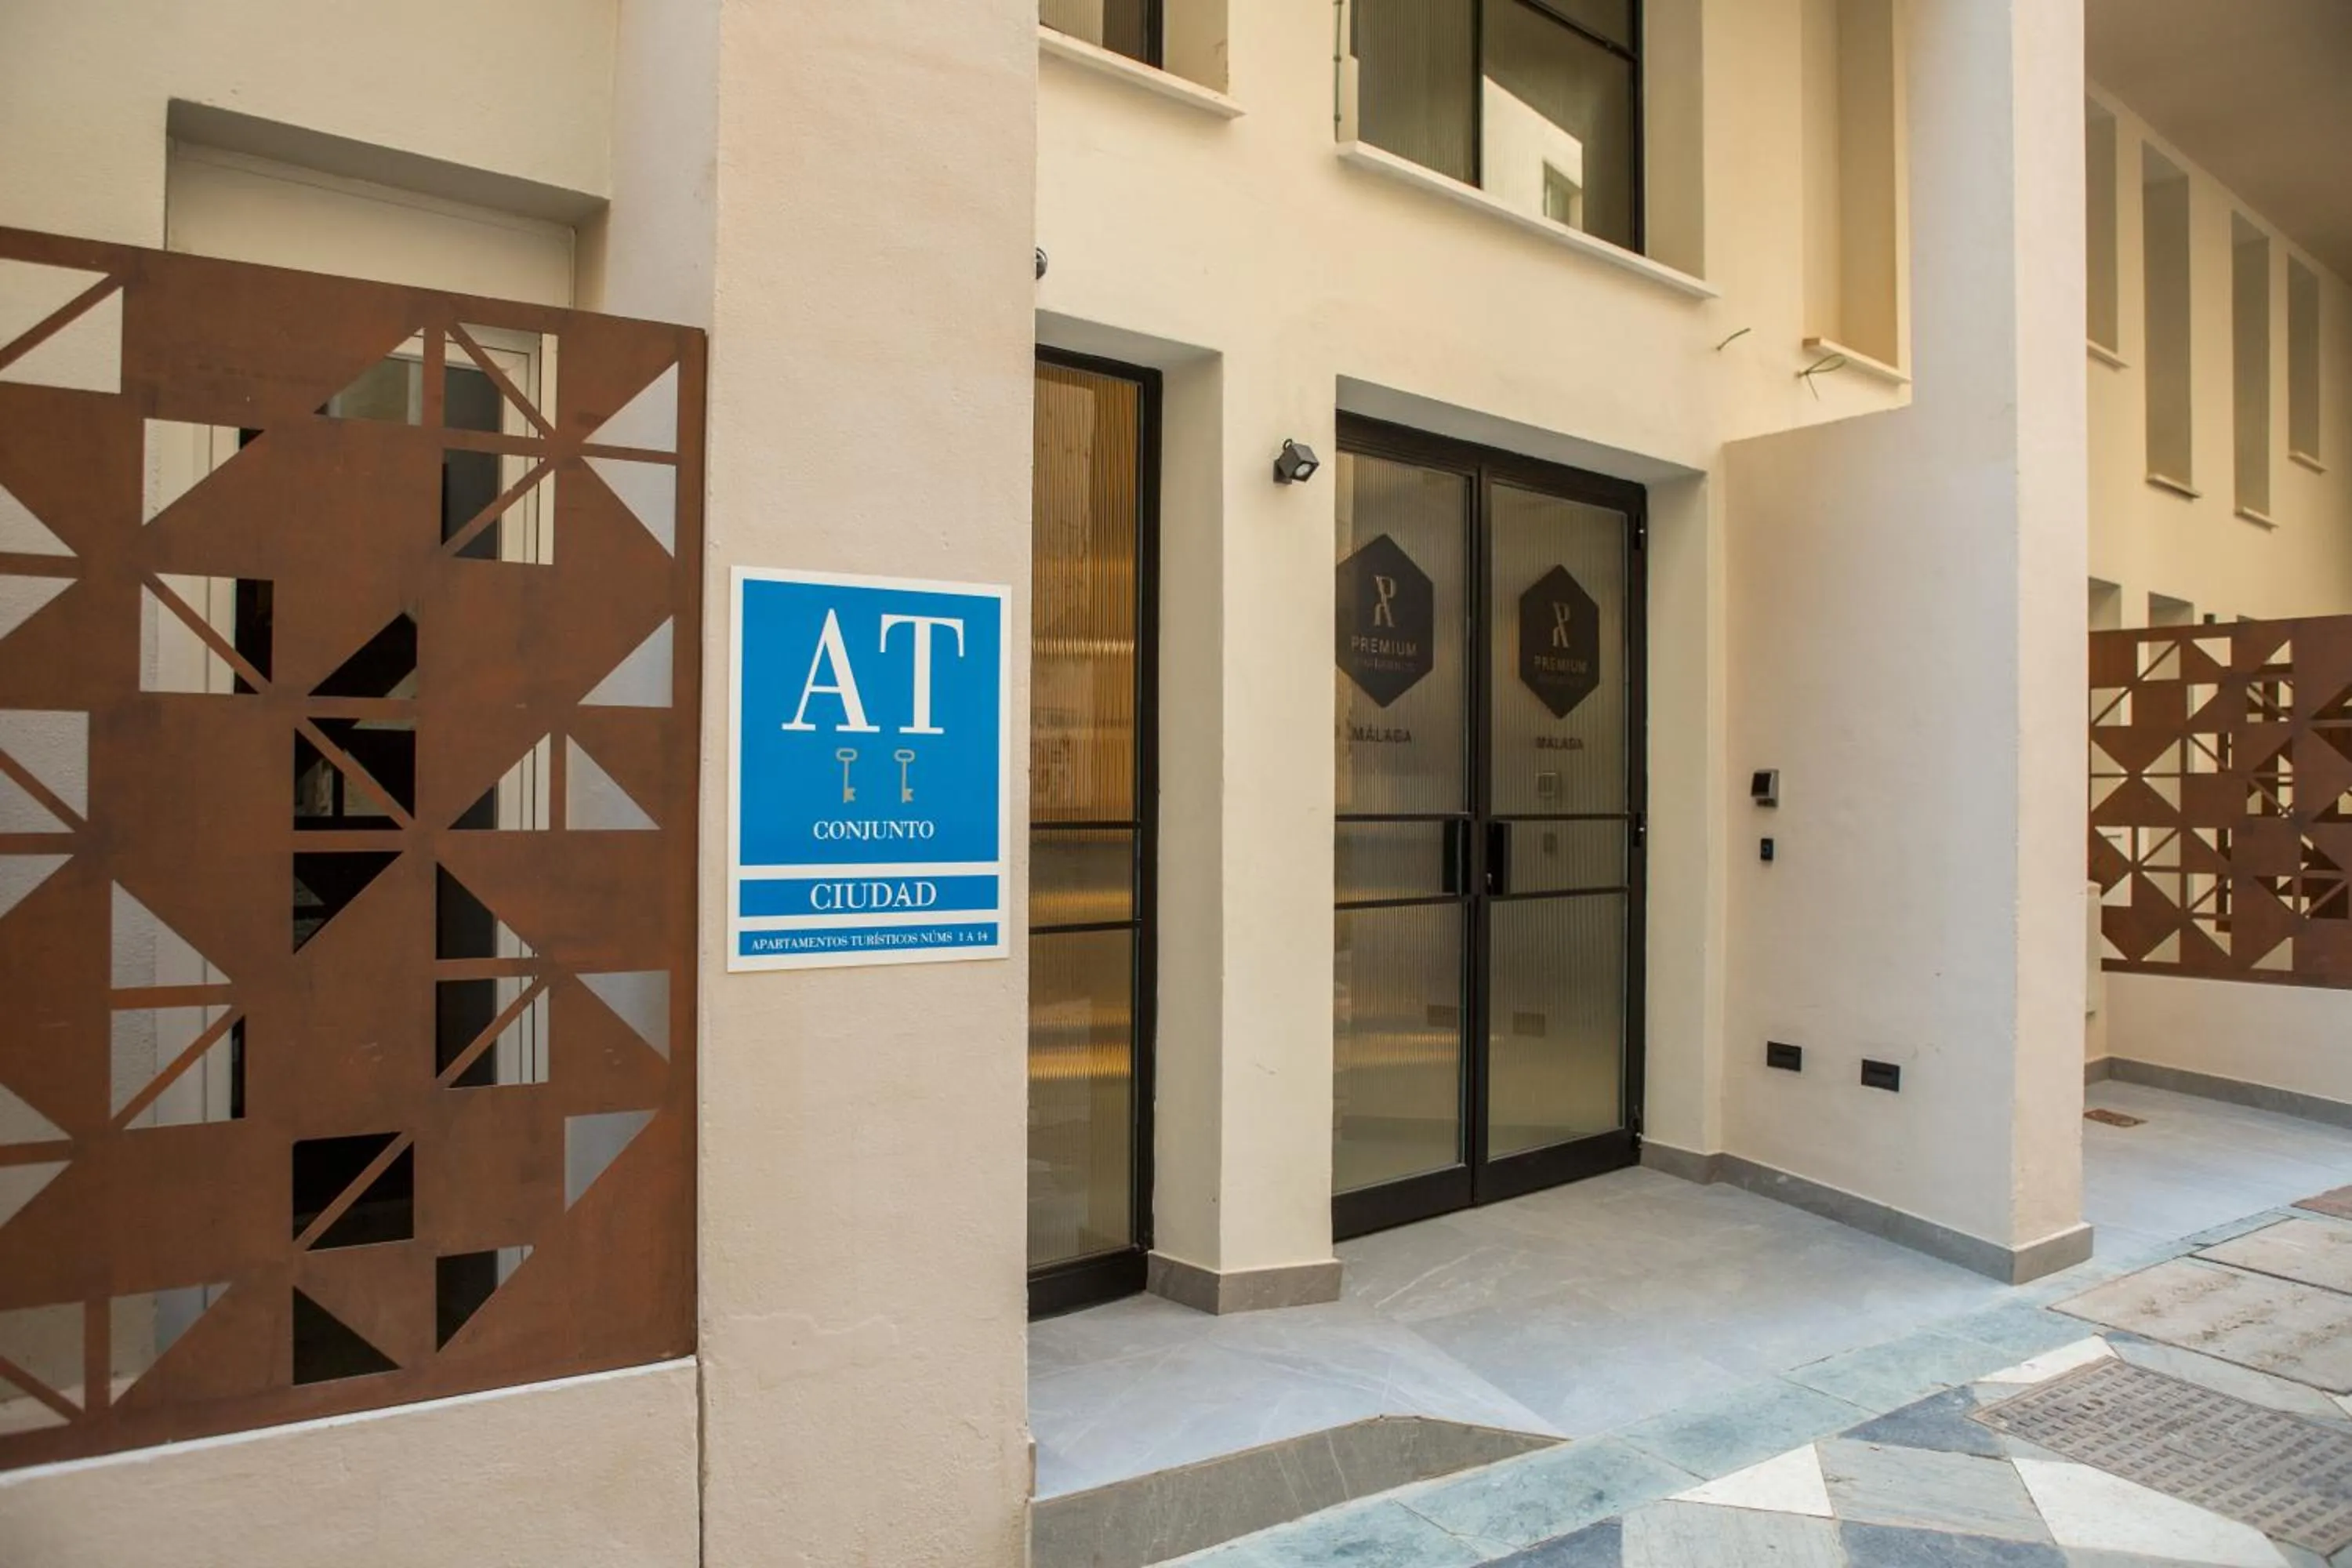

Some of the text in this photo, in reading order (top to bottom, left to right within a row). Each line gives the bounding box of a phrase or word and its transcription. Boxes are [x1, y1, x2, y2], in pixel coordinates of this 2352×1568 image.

[1350, 635, 1417, 657] PREMIUM
[781, 608, 964, 735] AT
[1534, 654, 1588, 674] PREMIUM
[813, 819, 935, 842] CONJUNTO
[810, 882, 938, 910] CIUDAD
[751, 935, 848, 950] APARTAMENTOS
[850, 931, 918, 946] TURÍSTICOS
[965, 931, 974, 942] A
